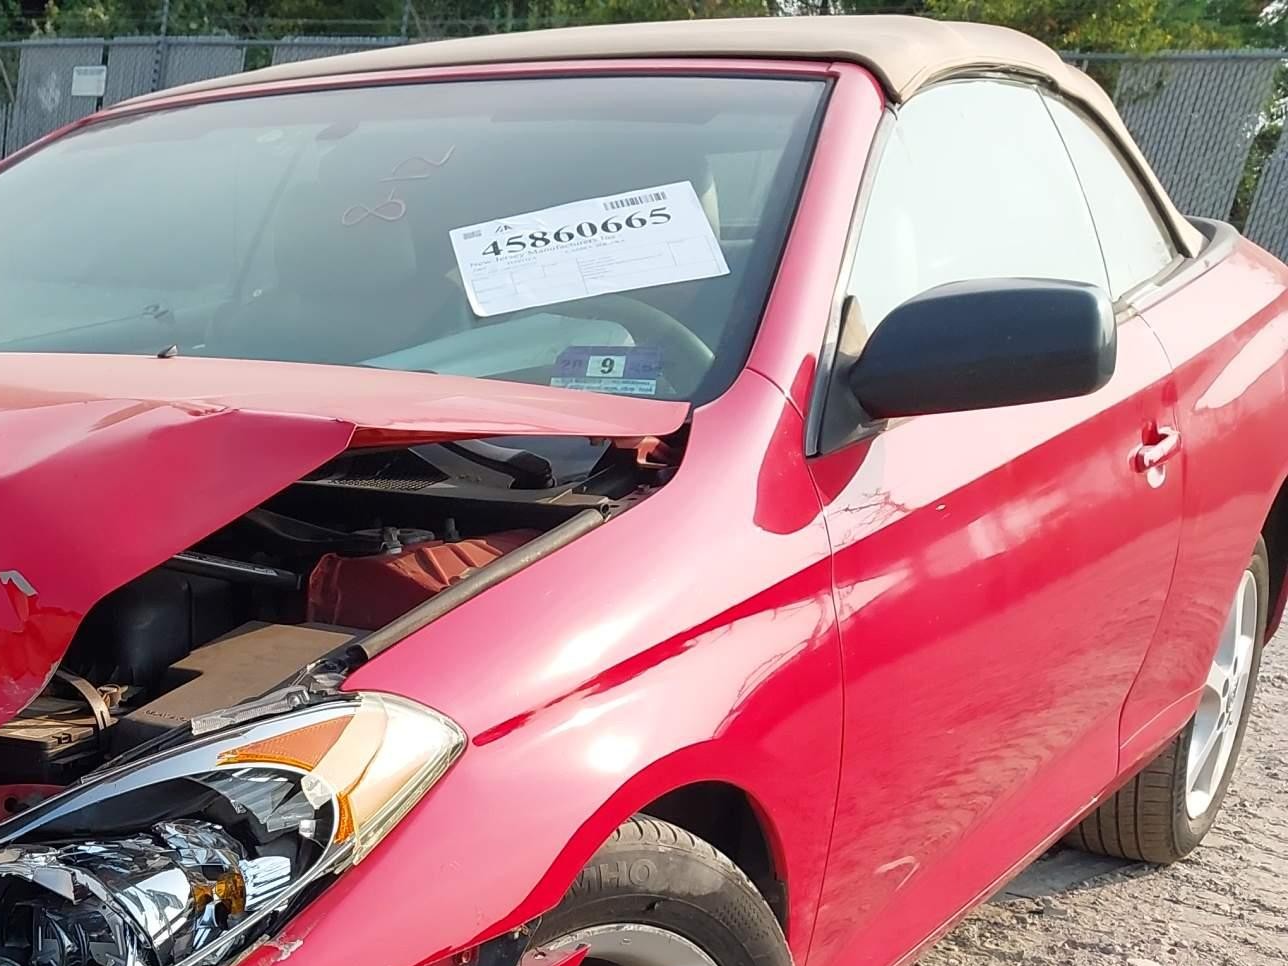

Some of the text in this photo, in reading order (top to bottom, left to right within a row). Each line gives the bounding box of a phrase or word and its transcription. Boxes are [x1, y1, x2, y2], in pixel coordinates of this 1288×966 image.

[481, 206, 672, 257] 45860665
[600, 357, 615, 374] 9
[570, 858, 659, 897] MHO
